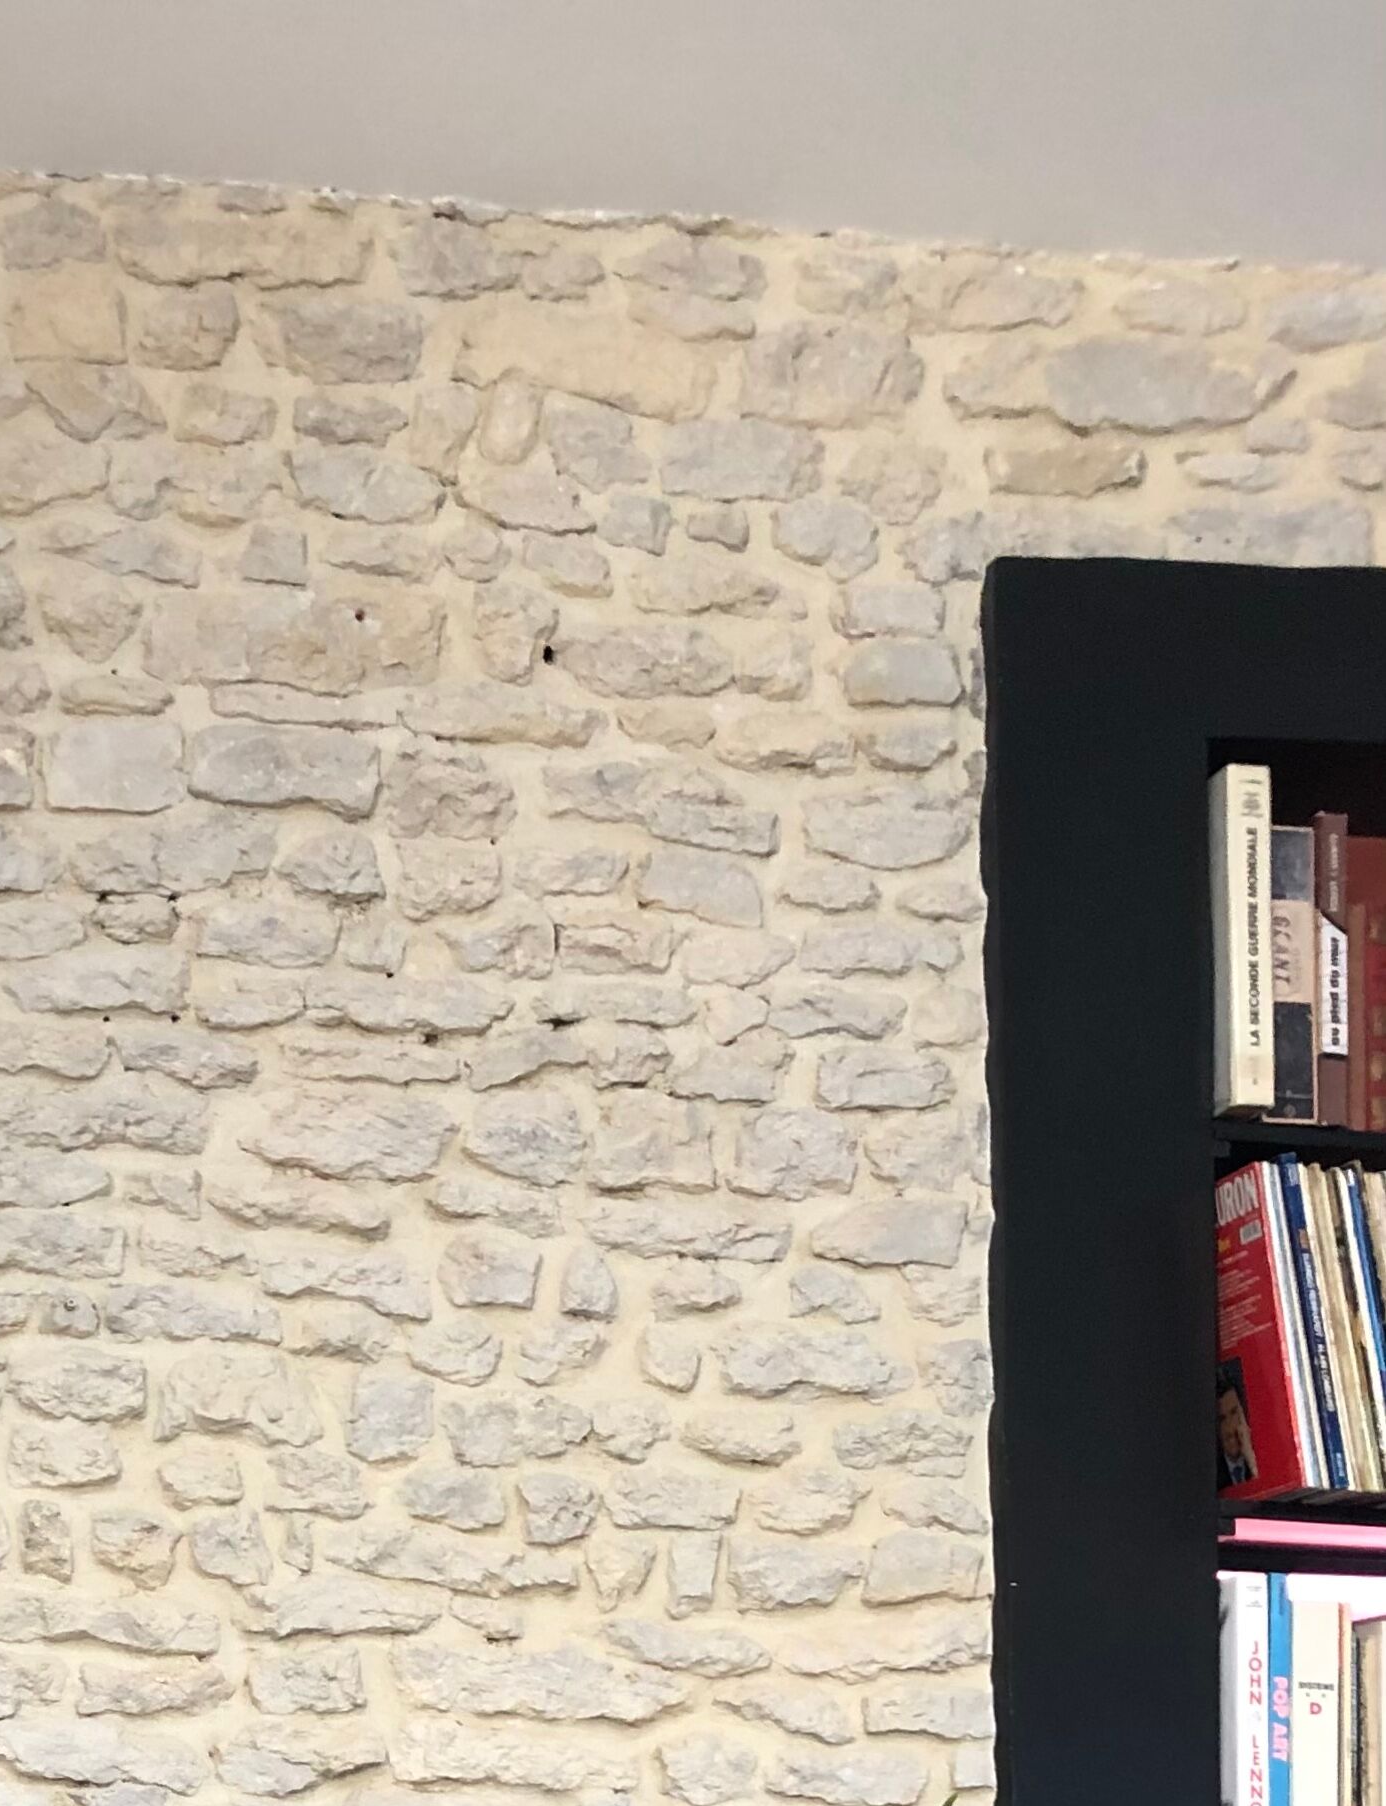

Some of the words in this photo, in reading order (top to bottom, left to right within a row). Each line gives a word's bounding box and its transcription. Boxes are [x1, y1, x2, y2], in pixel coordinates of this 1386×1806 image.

[1246, 827, 1259, 899] MONDIALE
[1248, 902, 1259, 957] GUERRE
[1248, 960, 1260, 1026] SECONDE
[1249, 1029, 1260, 1047] LA
[1214, 1169, 1259, 1227] URON
[1248, 1640, 1263, 1705] JOHN
[1273, 1675, 1289, 1719] POP
[1309, 1701, 1323, 1716] D
[1272, 1721, 1289, 1762] ART
